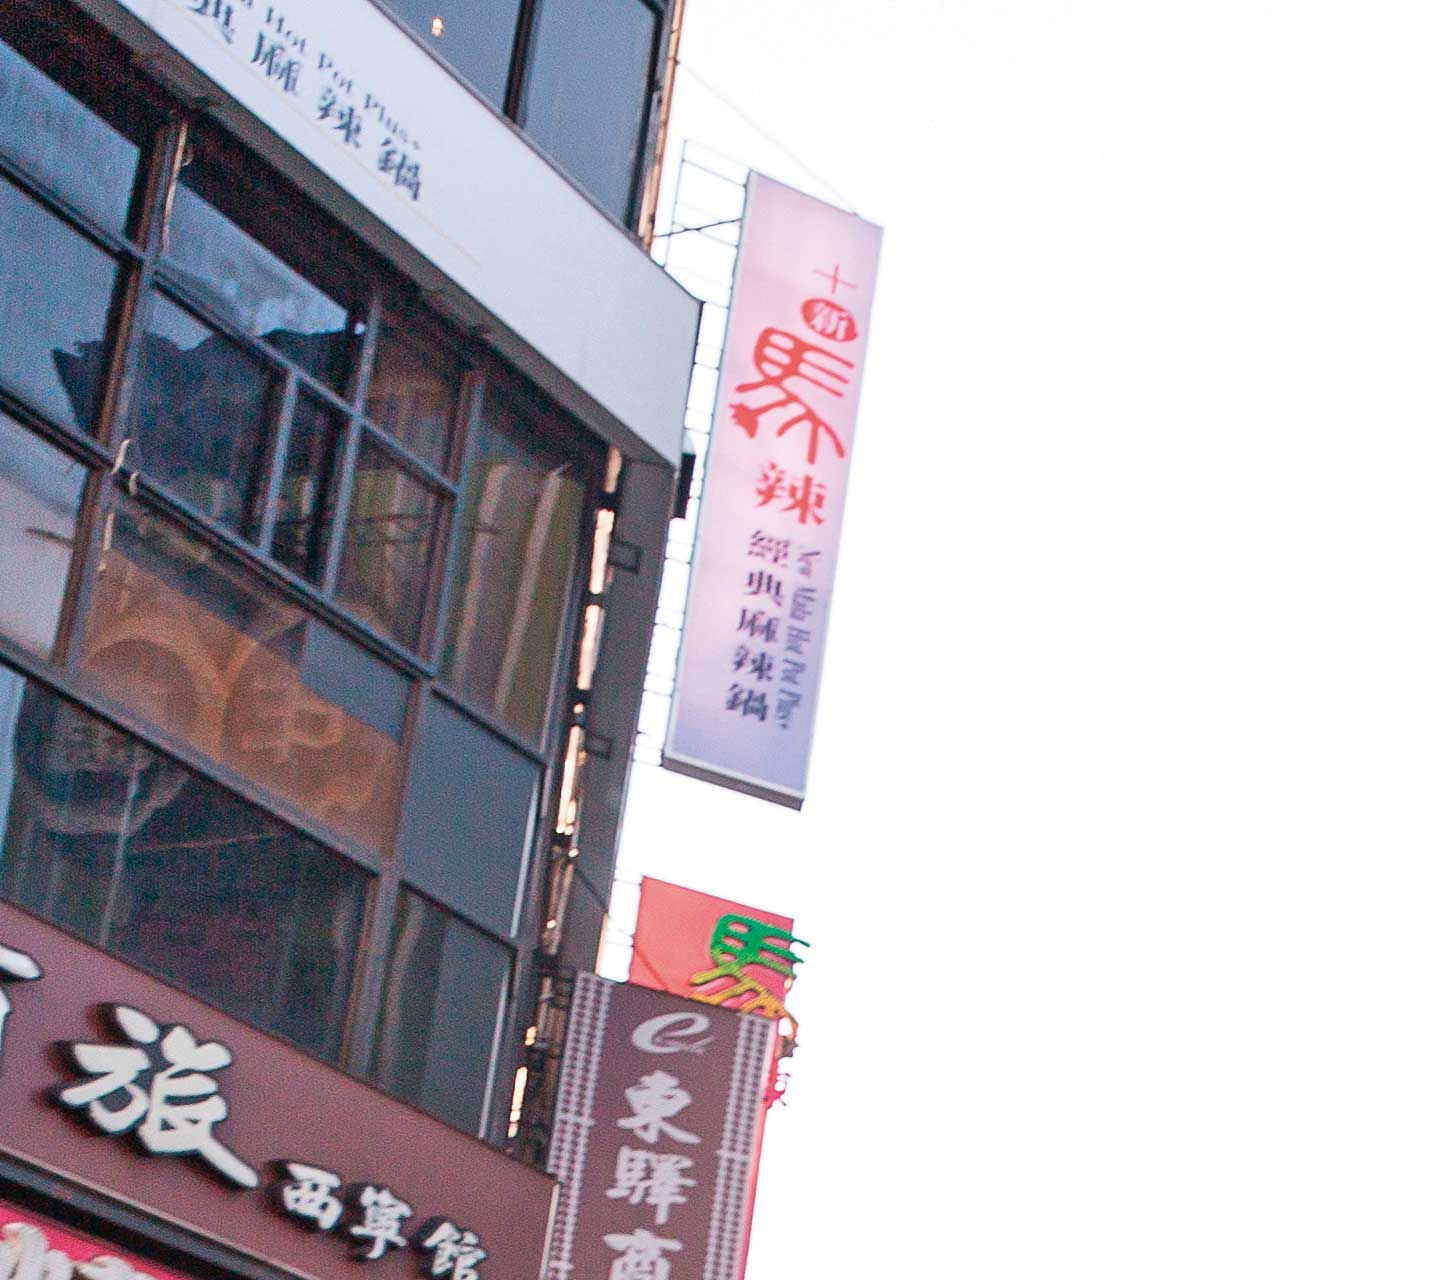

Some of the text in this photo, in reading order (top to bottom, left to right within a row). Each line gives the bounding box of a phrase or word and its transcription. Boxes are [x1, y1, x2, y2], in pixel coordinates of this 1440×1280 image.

[724, 528, 794, 724] 經典麻辣鍋
